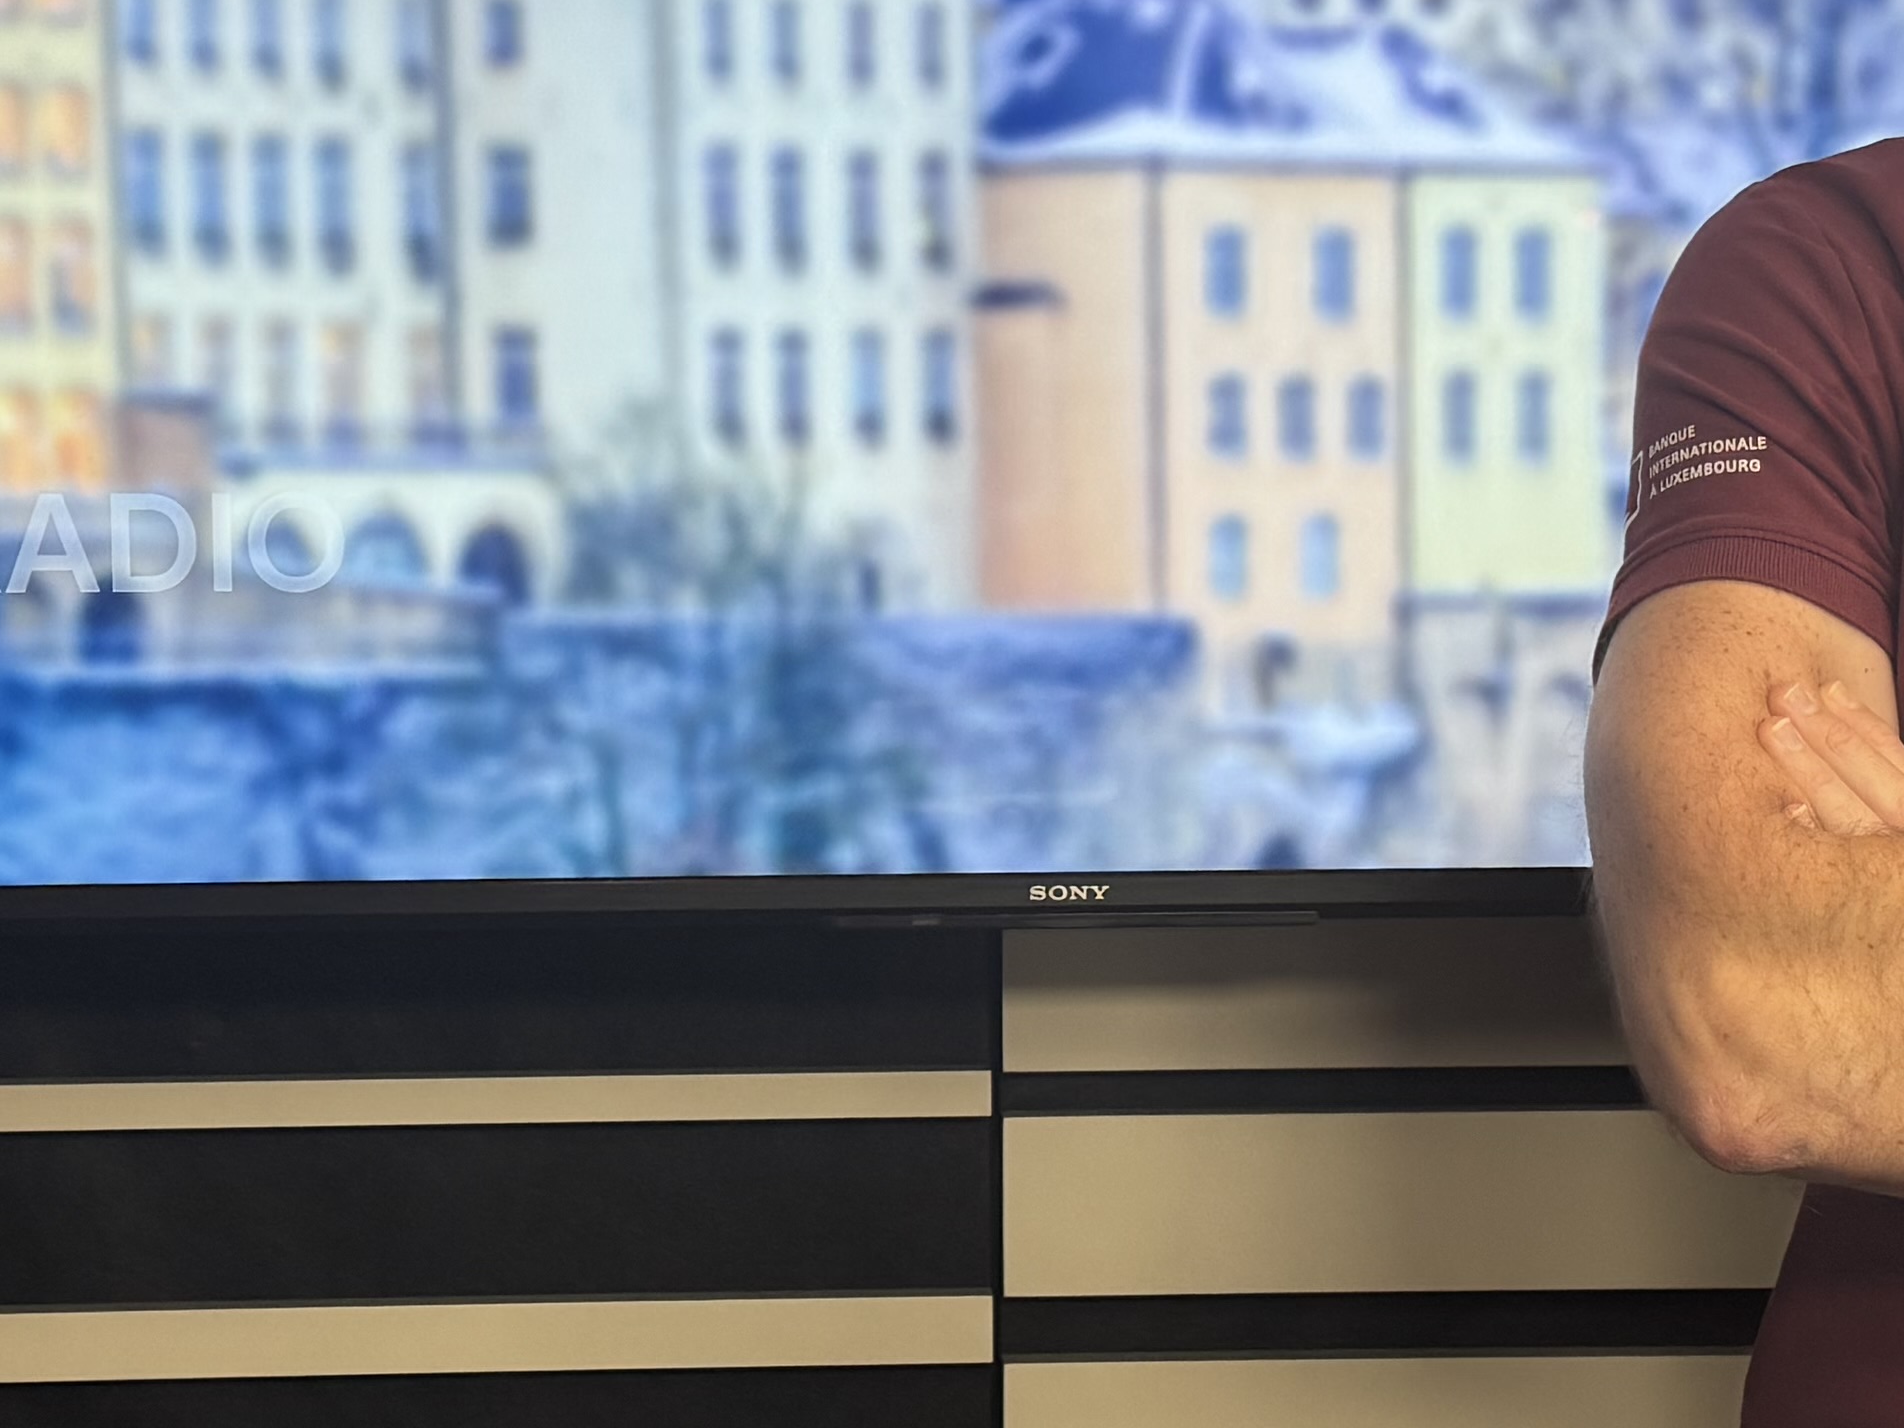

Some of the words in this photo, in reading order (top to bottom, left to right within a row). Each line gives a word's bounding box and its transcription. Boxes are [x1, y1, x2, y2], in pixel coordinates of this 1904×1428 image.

[1648, 424, 1696, 459] BANQUE
[1649, 435, 1768, 478] INTERNATIONALE
[1660, 458, 1762, 492] LUXEMBOURG
[1028, 884, 1110, 902] SONY
